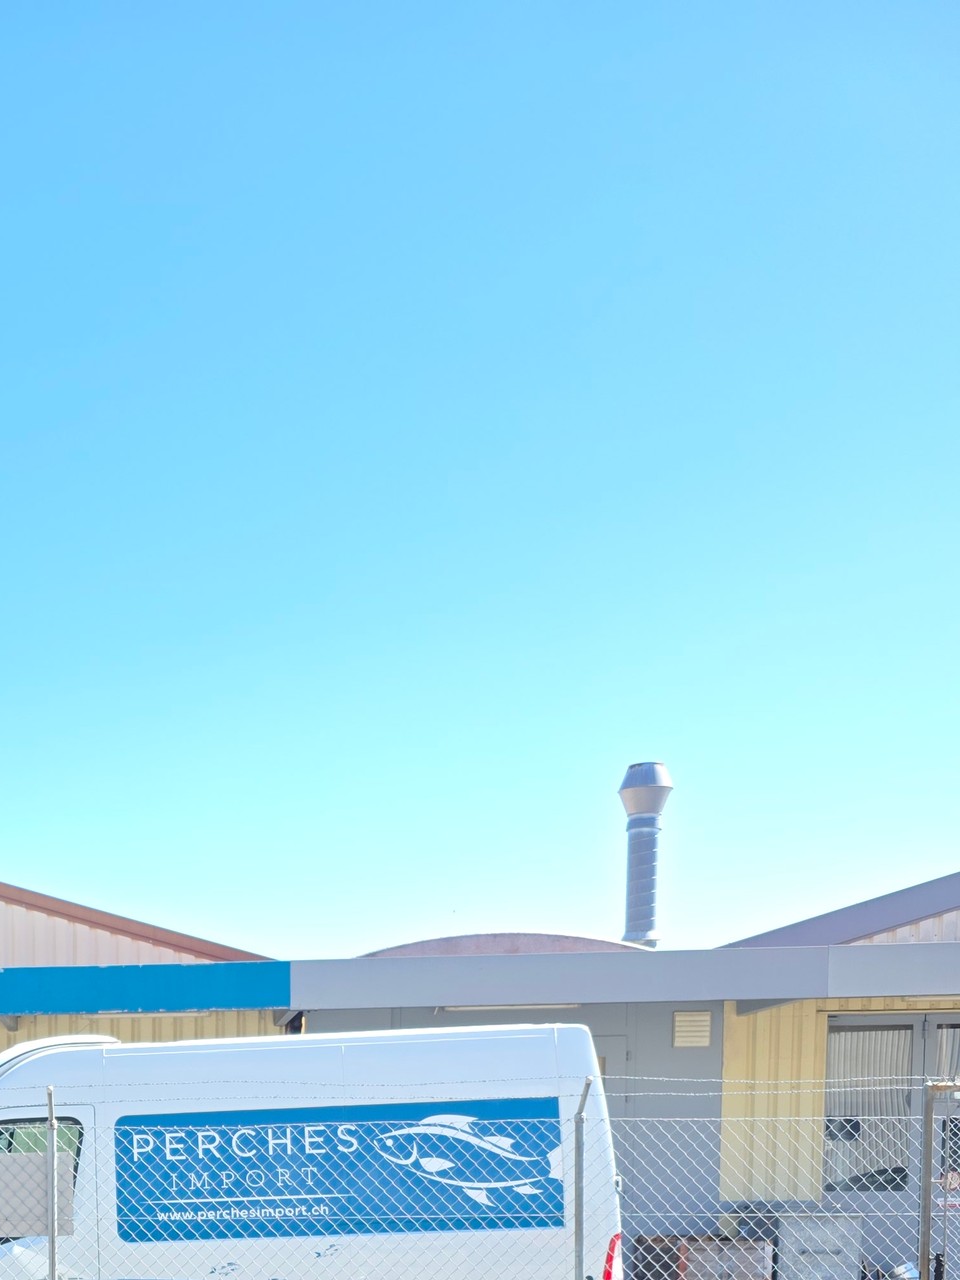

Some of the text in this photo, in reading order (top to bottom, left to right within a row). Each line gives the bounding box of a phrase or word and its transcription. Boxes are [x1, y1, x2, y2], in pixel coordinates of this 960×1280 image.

[132, 1124, 358, 1161] PERCHES
[170, 1167, 317, 1191] IMPORT
[156, 1203, 329, 1221] www.perchesimport.ch
